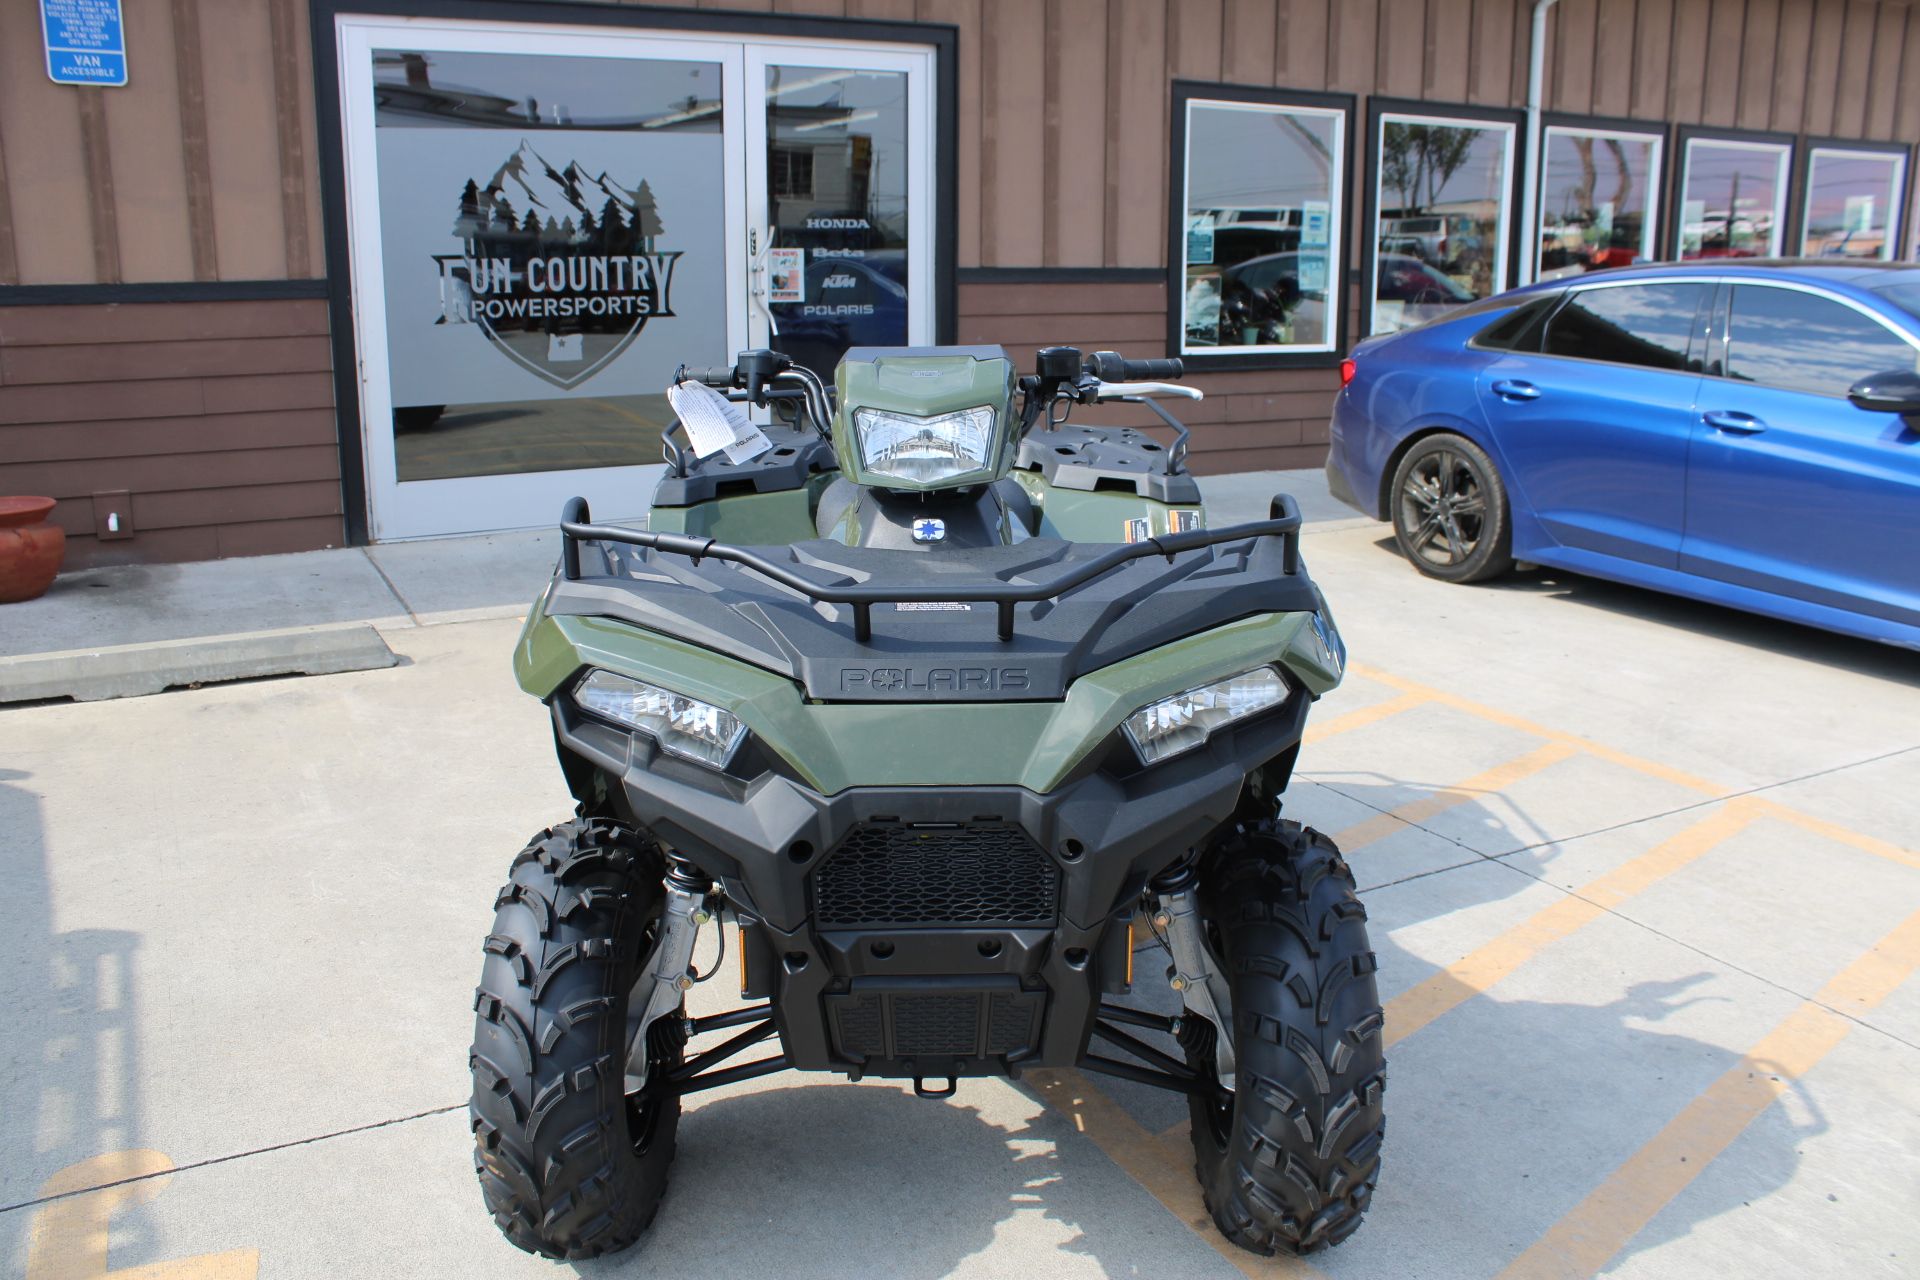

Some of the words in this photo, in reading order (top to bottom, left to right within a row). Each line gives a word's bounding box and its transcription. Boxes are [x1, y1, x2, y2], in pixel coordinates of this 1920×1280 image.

[74, 54, 101, 66] VAN
[61, 66, 115, 77] ACCESSIBLE
[806, 218, 870, 229] HONDA
[812, 248, 864, 258] Beta
[822, 274, 856, 288] KTM
[440, 257, 512, 324] FUN
[527, 254, 675, 315] COUNTRY
[471, 296, 651, 320] POWERSPORTS
[804, 304, 875, 316] POLARIS
[735, 433, 759, 447] POLARIS
[840, 667, 1031, 692] POLARIS
